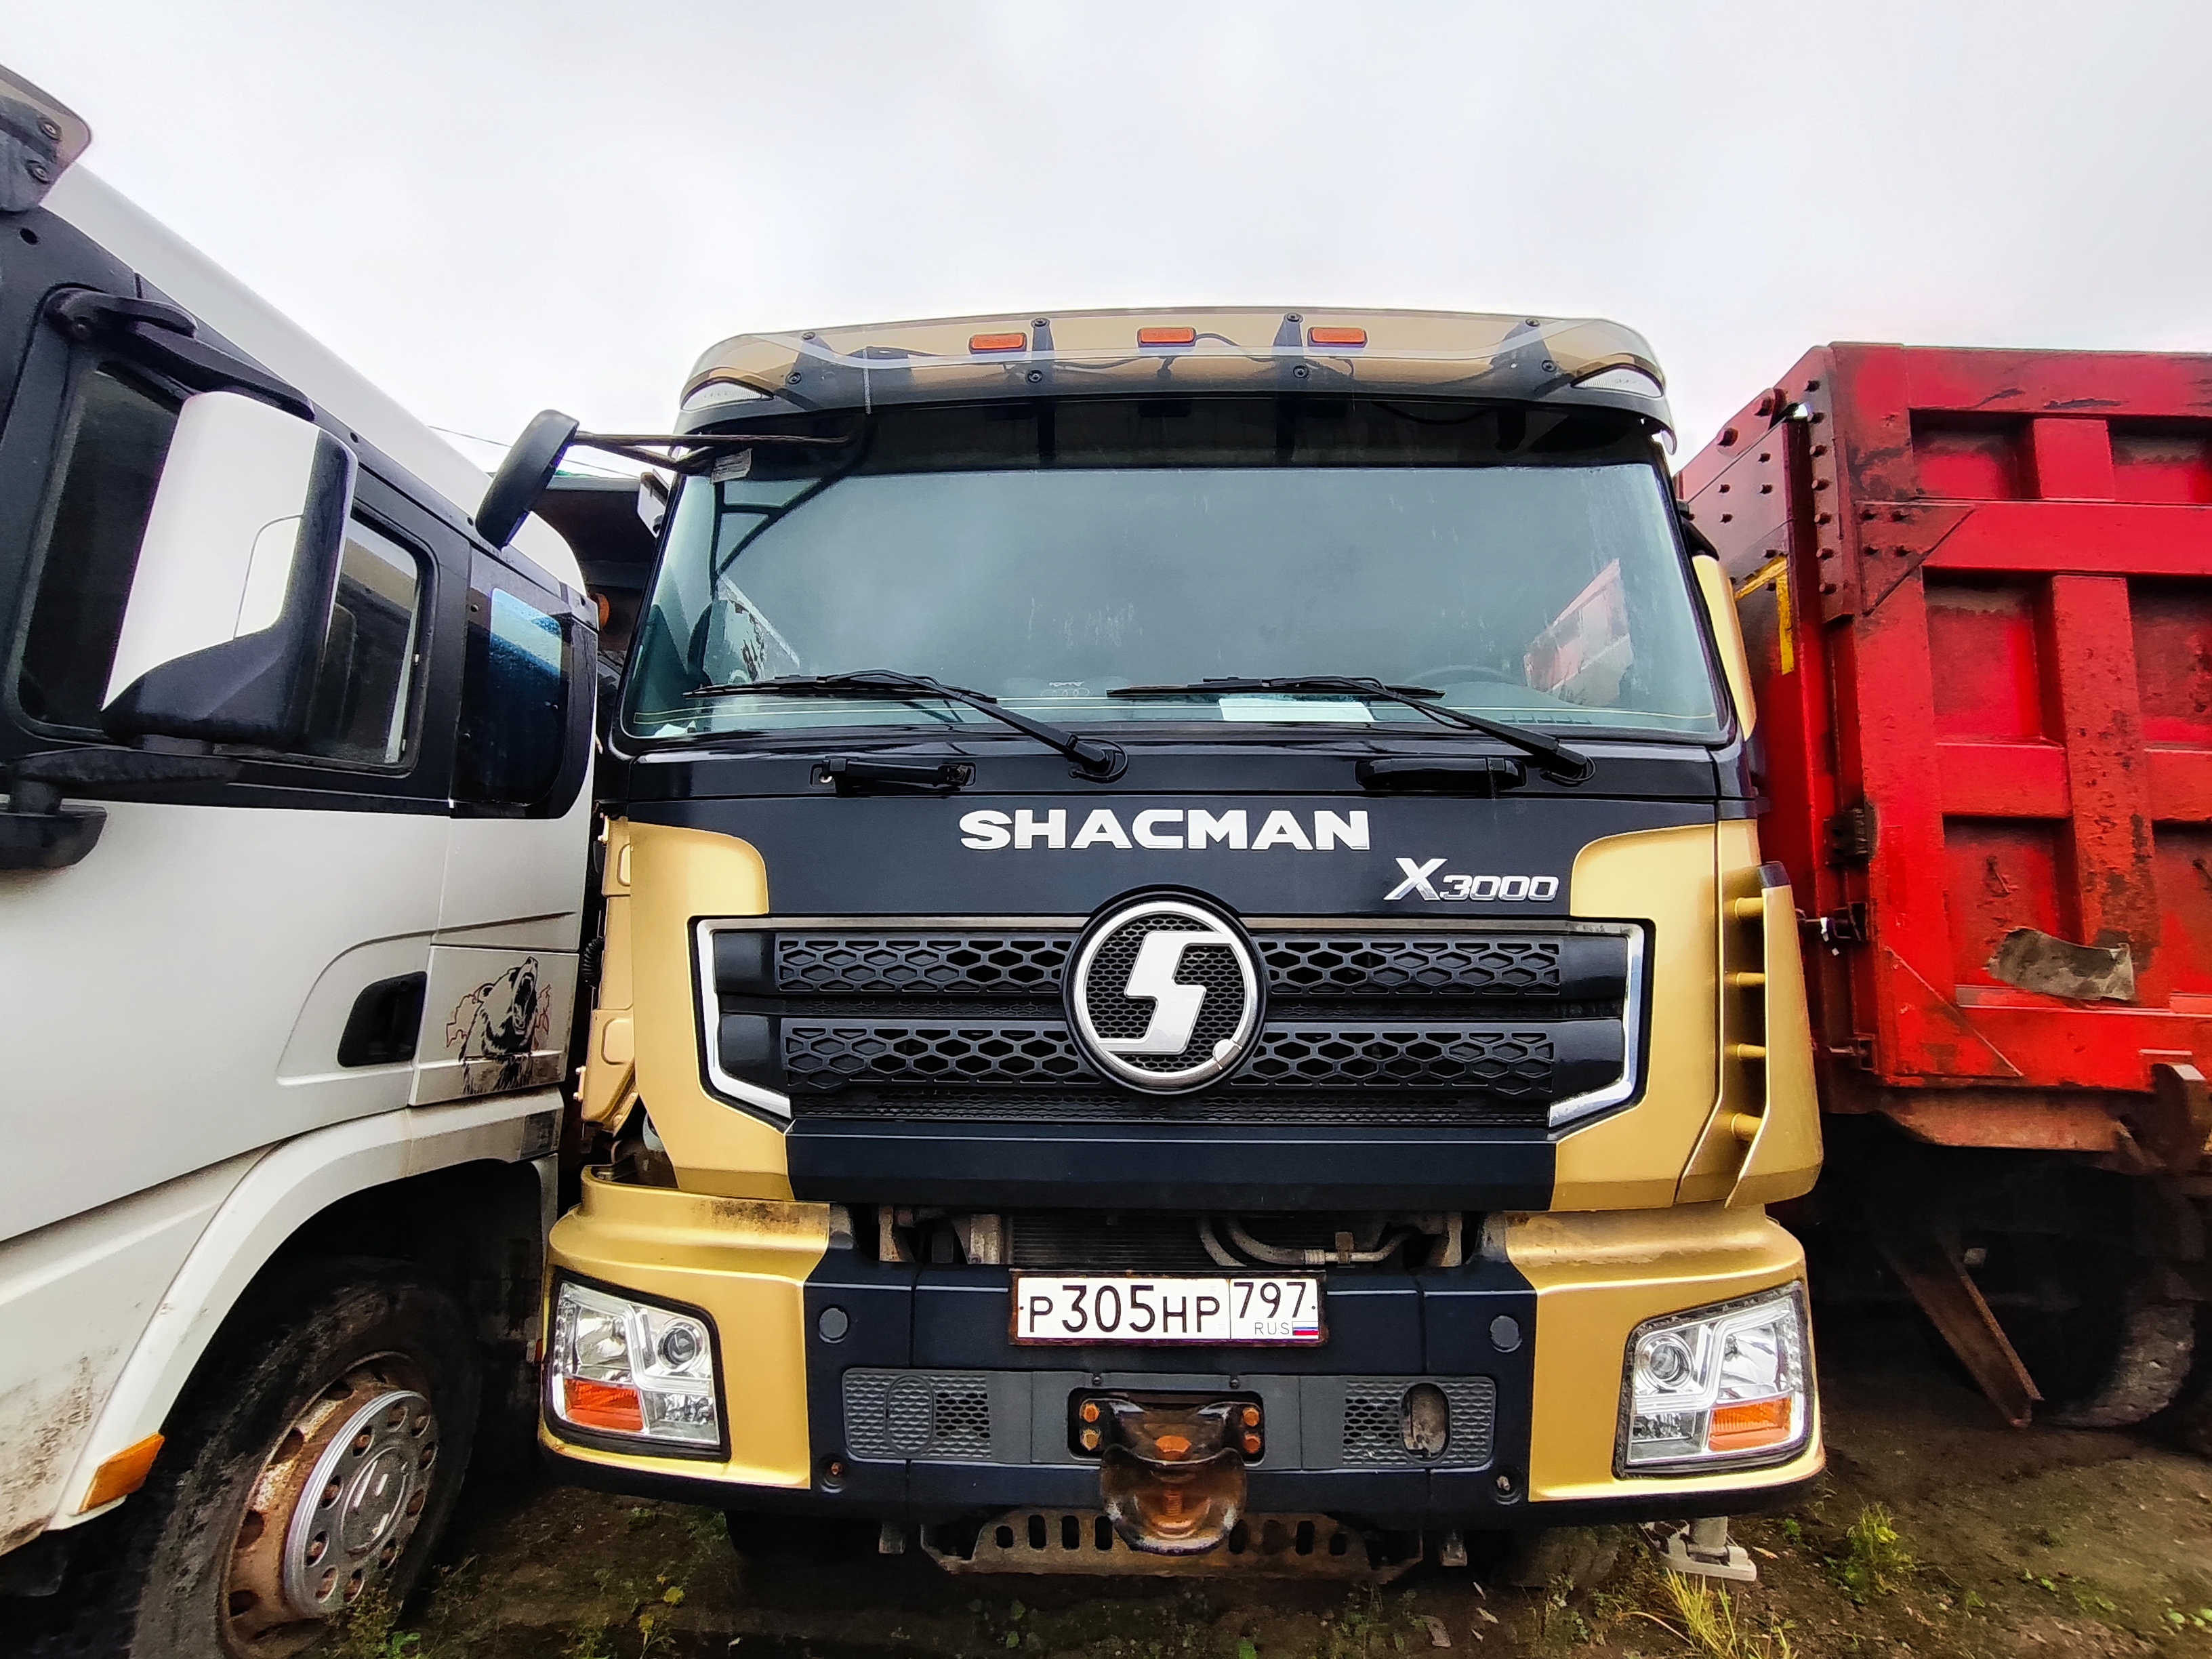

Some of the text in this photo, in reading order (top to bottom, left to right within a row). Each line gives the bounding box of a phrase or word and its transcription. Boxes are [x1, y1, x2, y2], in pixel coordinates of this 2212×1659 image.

[959, 808, 1370, 851] SHACMAN
[1383, 857, 1559, 901] X3000
[1233, 1282, 1307, 1319] 797
[1254, 1322, 1290, 1335] RUS
